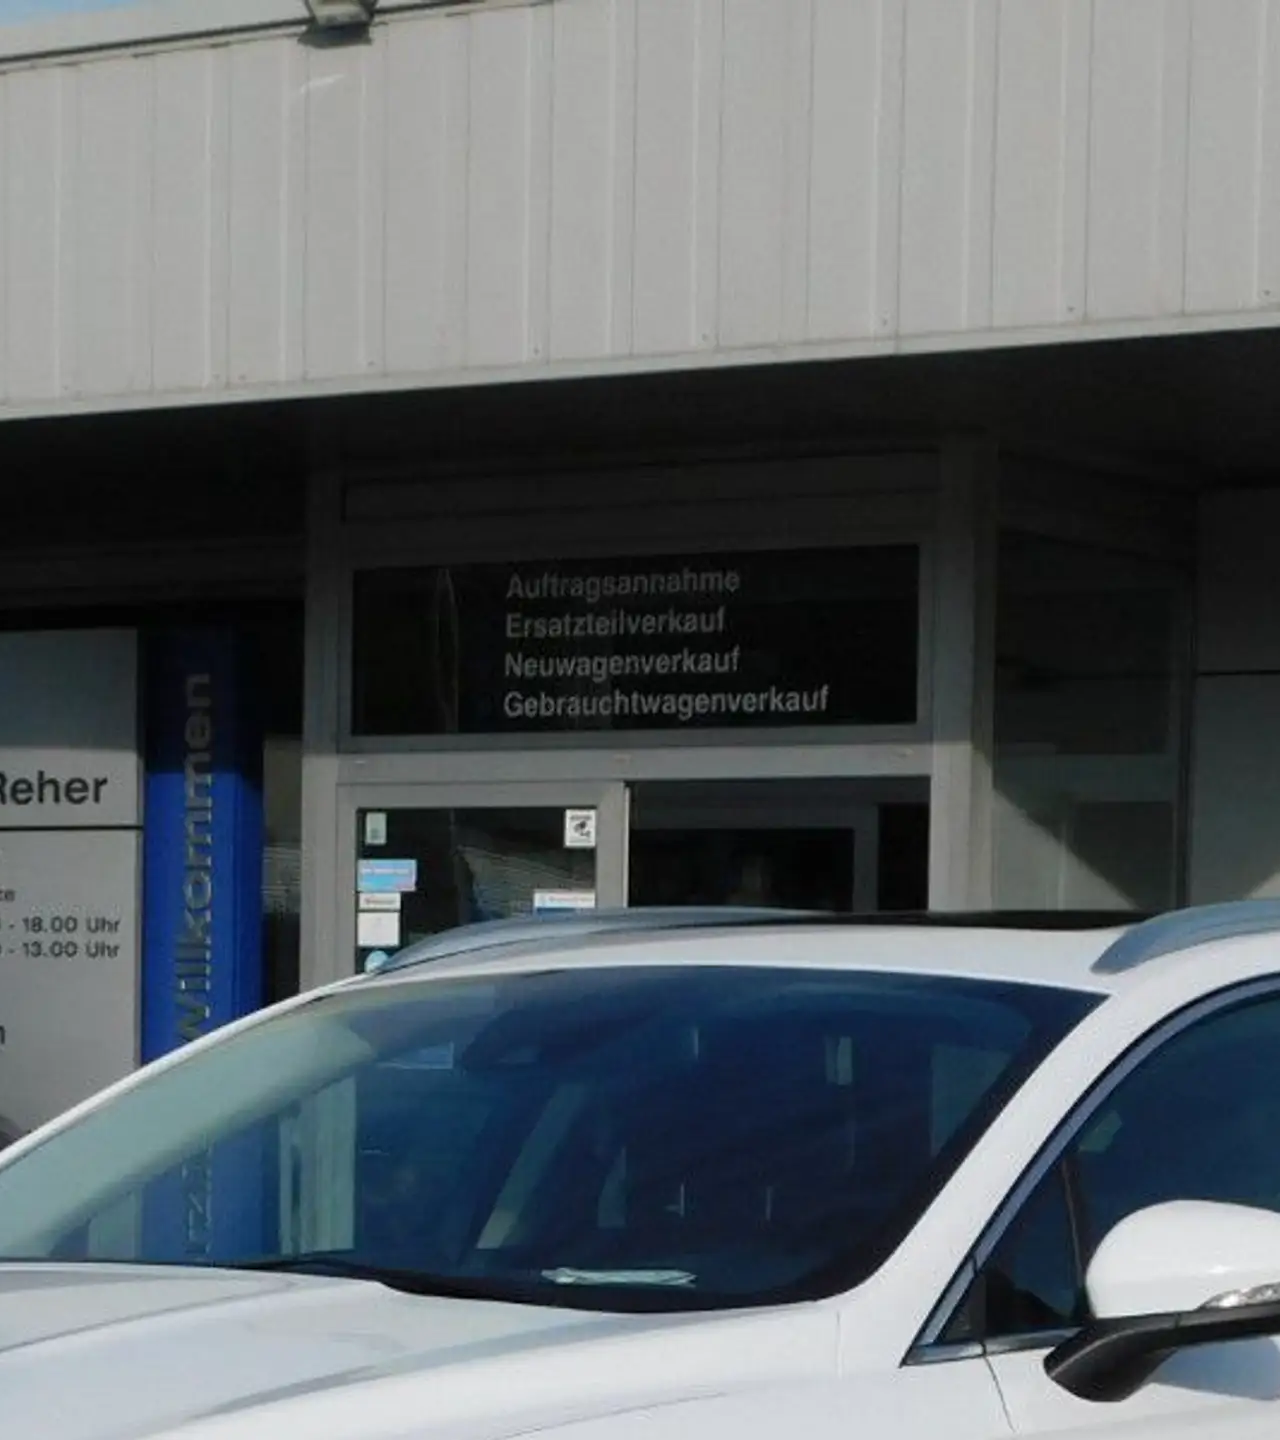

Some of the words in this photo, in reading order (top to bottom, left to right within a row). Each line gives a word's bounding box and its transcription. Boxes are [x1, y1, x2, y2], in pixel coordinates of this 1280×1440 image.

[506, 567, 740, 602] Auftragsannahme
[505, 606, 727, 638] Ersatzteilverkauf
[504, 645, 741, 682] Neuwagenverkauf
[503, 684, 830, 721] Gebrauchtwagenverkauf
[22, 915, 79, 934] 18.00
[84, 915, 121, 934] Uhr
[84, 939, 121, 959] Uhr
